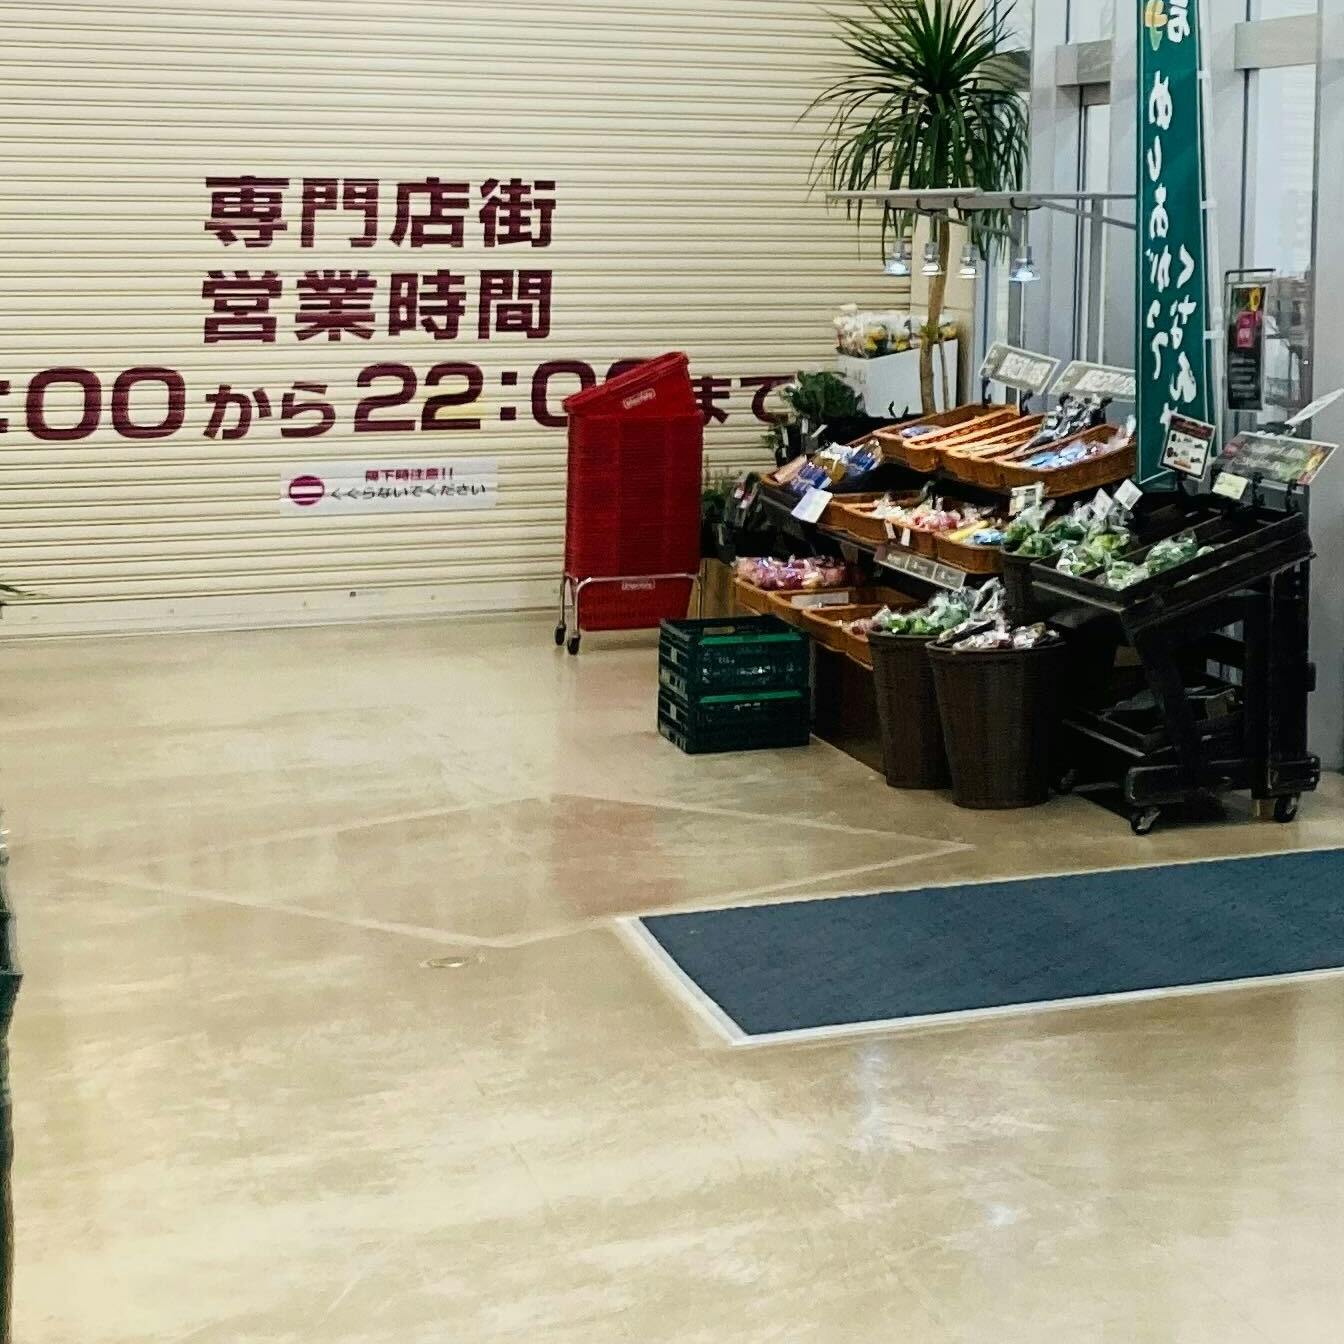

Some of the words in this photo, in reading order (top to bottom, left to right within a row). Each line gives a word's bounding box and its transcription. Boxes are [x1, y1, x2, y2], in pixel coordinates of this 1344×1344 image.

[204, 175, 557, 249] 専門店街
[201, 268, 553, 344] 営業時間
